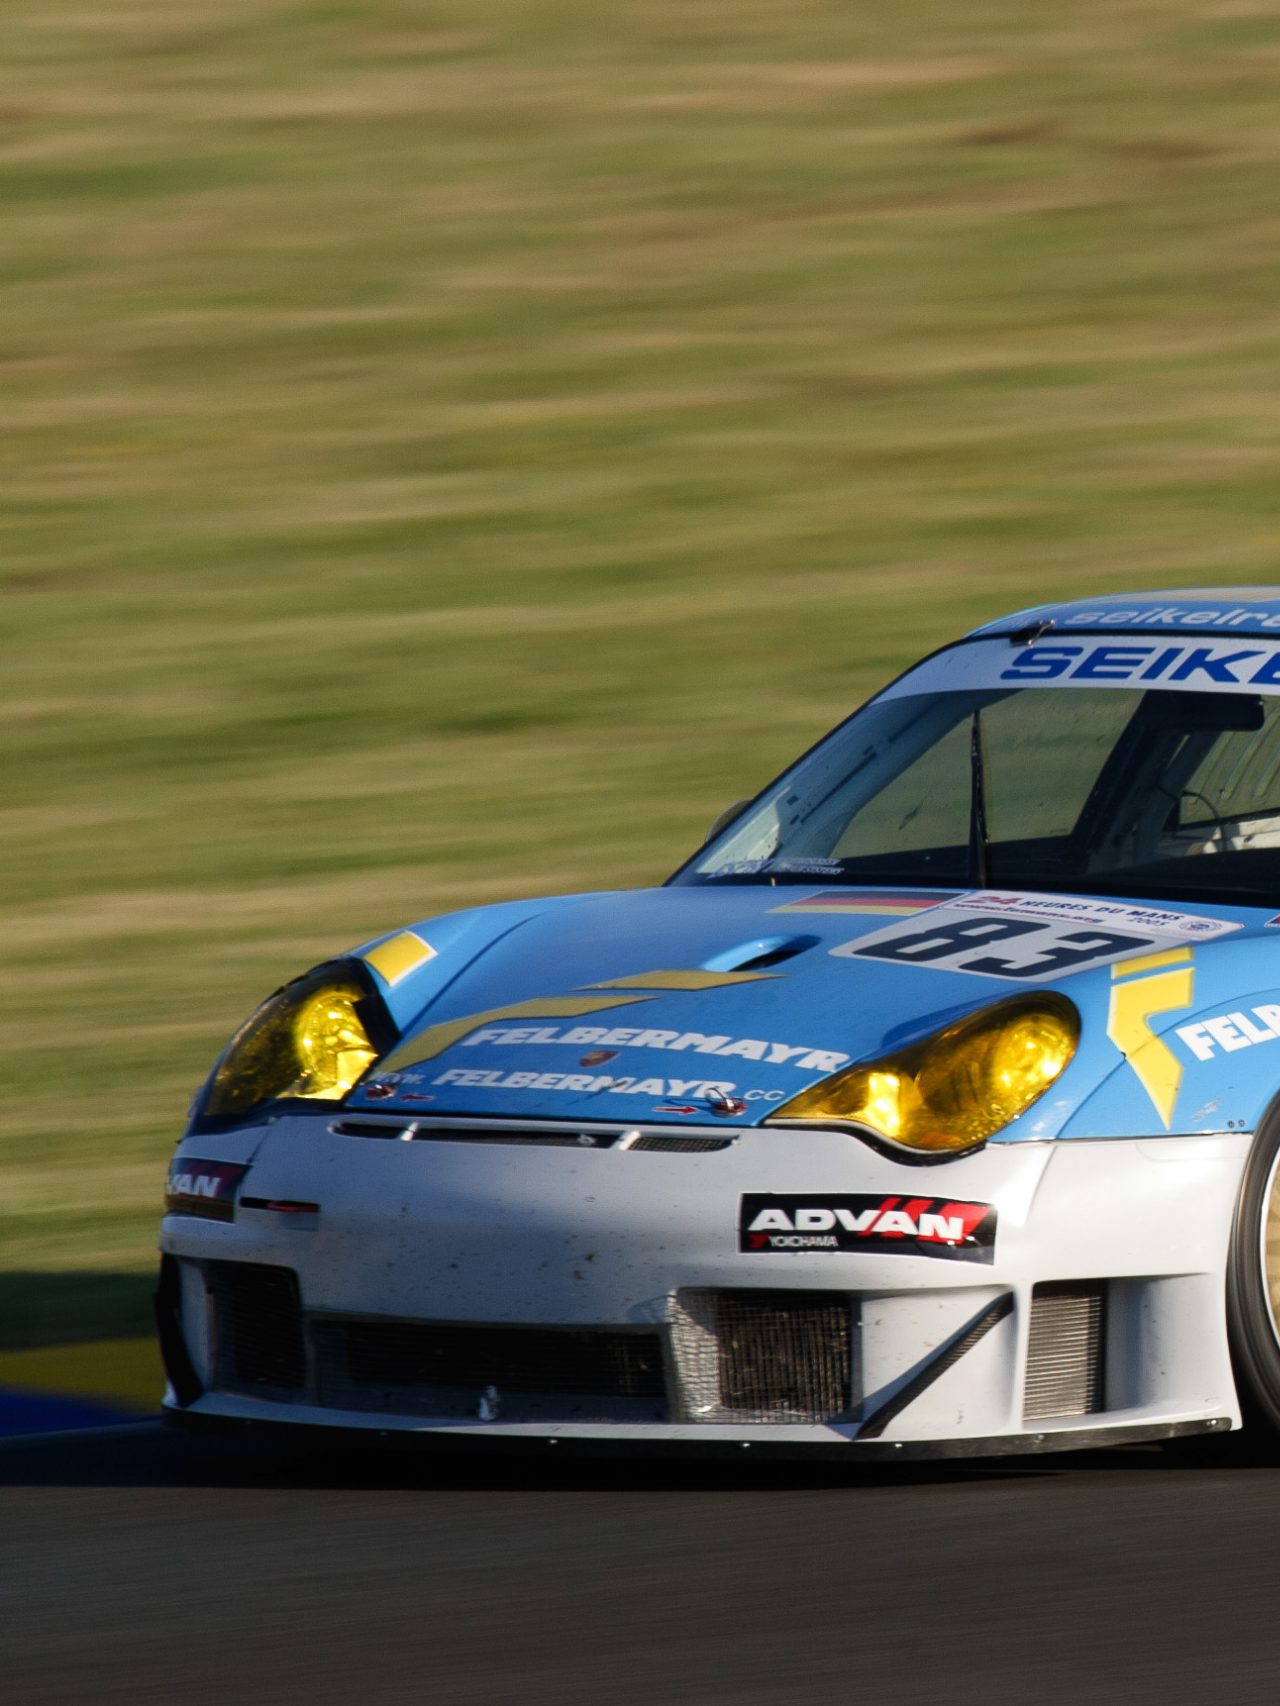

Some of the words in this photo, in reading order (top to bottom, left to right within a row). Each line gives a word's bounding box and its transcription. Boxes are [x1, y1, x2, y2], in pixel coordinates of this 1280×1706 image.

[1020, 900, 1092, 910] HEURES
[1127, 910, 1184, 921] MANS
[853, 917, 1155, 977] 83
[464, 1027, 850, 1072] FELBERMAYR
[431, 1069, 736, 1098] FELBERMAYR
[748, 1209, 963, 1240] ADVAN
[768, 1235, 838, 1248] YOKOHAMA
